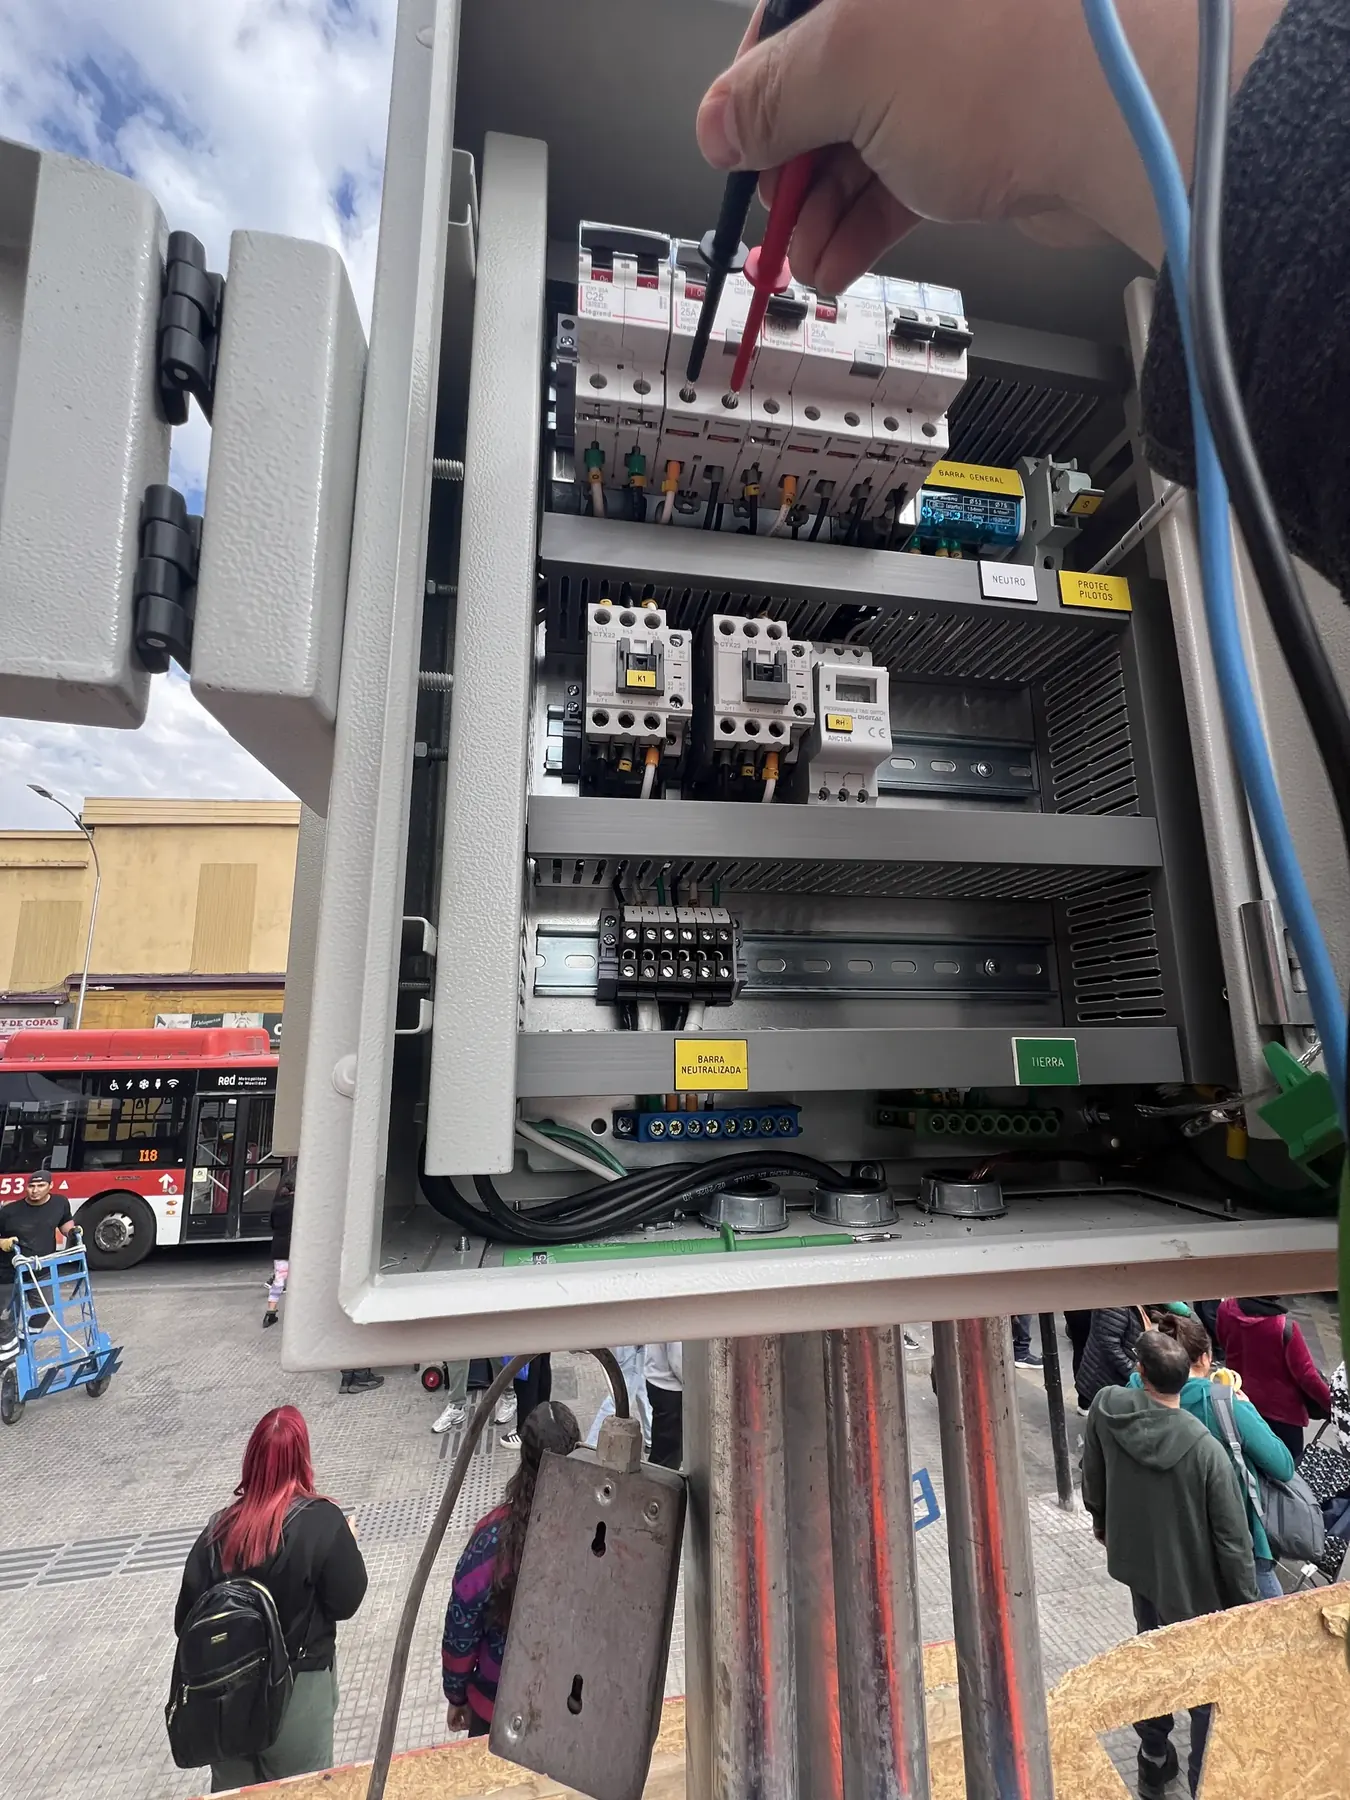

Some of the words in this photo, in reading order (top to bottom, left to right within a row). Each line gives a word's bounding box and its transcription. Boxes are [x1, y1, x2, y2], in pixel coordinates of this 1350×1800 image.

[586, 292, 604, 301] C25
[585, 307, 612, 317] legrand
[680, 308, 696, 317] 25A
[812, 329, 826, 338] 25A
[770, 336, 794, 346] legrand
[811, 345, 834, 354] legrand
[938, 469, 966, 480] BARRA
[969, 473, 1004, 484] GENERAL
[992, 575, 1026, 587] NEUTRO
[1078, 580, 1110, 592] PROTEC
[1080, 590, 1114, 602] PILOTOS
[637, 674, 646, 683] K1
[858, 714, 884, 722] DIGITAL
[698, 1055, 725, 1064] BARRA
[1032, 1056, 1065, 1068] TIERRA
[682, 1066, 742, 1075] NEUTRALIZADA
[218, 1074, 236, 1086] Red
[139, 1150, 158, 1162] I18
[0, 1177, 25, 1195] 53
